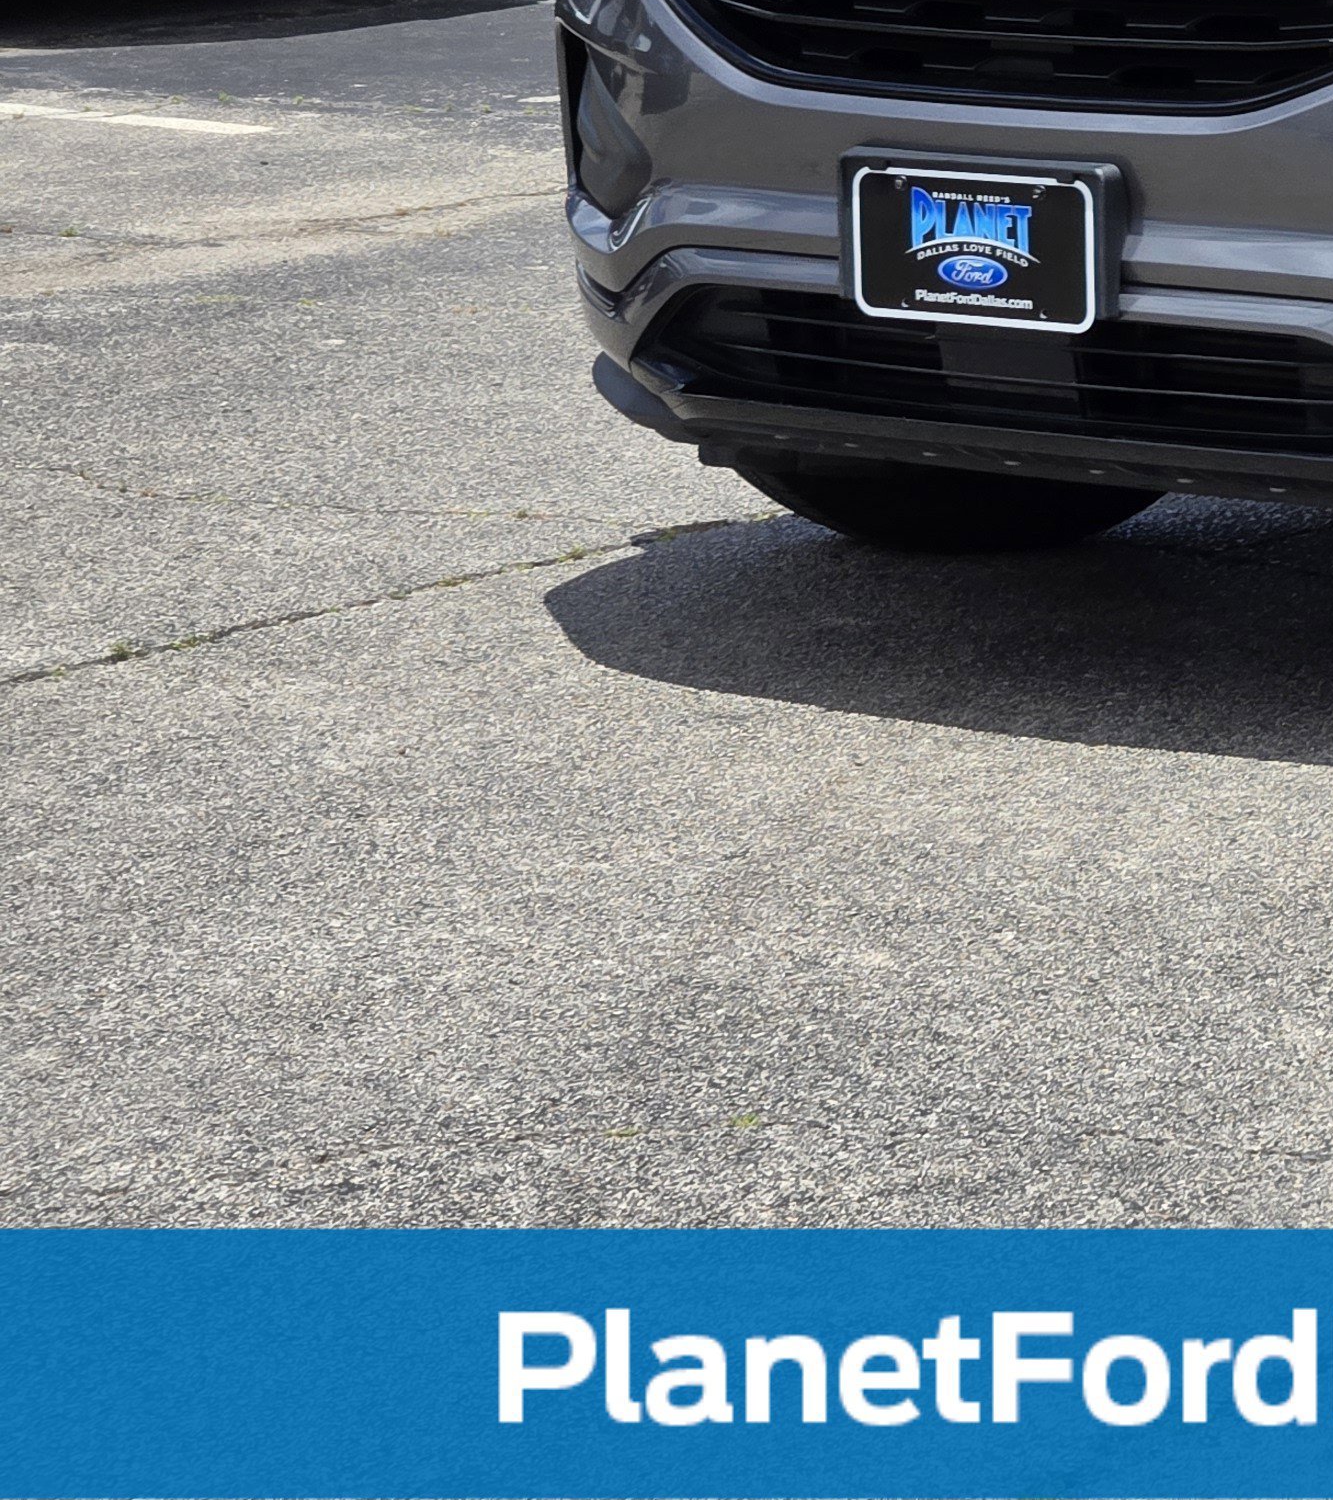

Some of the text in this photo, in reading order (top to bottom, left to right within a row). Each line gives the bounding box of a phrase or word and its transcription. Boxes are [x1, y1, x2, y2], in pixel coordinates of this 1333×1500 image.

[911, 186, 1033, 255] PLANET
[916, 243, 1030, 268] DALLAS LOVE FIELD
[950, 259, 994, 285] Ford
[914, 289, 1033, 310] PlanetFordDallas.com
